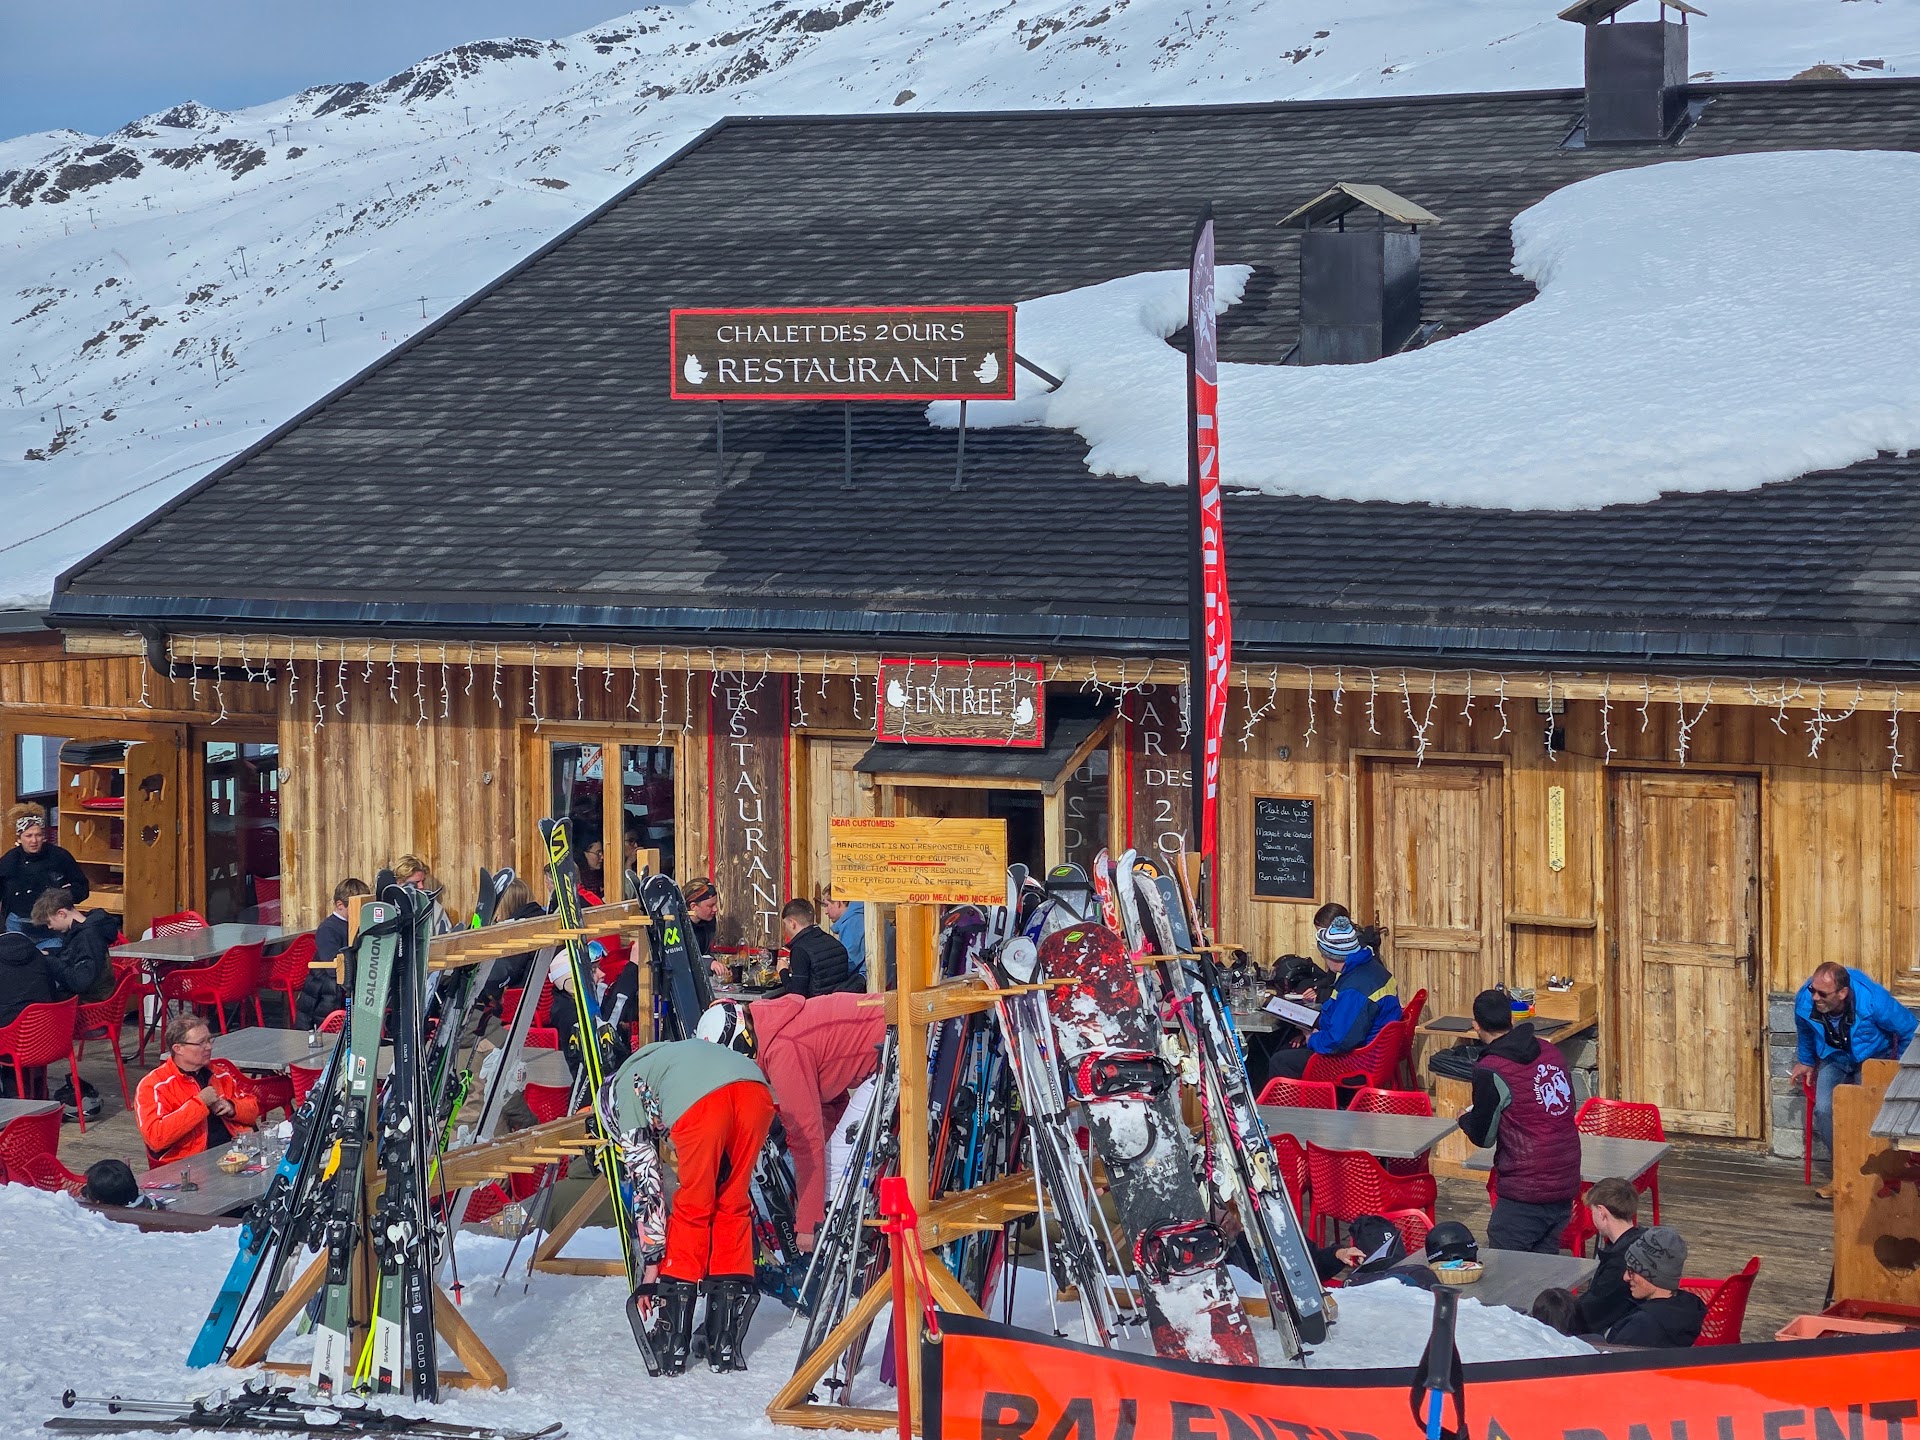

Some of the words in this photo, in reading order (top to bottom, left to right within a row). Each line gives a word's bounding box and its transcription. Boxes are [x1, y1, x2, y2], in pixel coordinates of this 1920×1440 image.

[717, 324, 816, 343] CHALET
[820, 323, 867, 342] DES
[718, 357, 967, 384] RESTAURANT
[915, 686, 1003, 715] ENTREE
[720, 670, 778, 934] RESTAURANT
[831, 818, 851, 827] DEAR
[852, 819, 895, 828] CUSTOMERS
[854, 853, 874, 861] LOSS
[917, 843, 972, 851] RESPONSIBLE
[974, 844, 990, 852] FOR
[848, 864, 889, 873] DIRECTION
[914, 865, 929, 874] PAS
[930, 866, 981, 875] RESPONSABLE
[860, 876, 884, 884] PERTE
[909, 893, 930, 901] GOOD
[932, 893, 952, 902] MEAL
[954, 894, 969, 902] AND
[971, 894, 989, 903] NICE
[990, 895, 1004, 904] DAY
[364, 935, 382, 1008] SALOMON
[781, 1221, 799, 1255] CLOUD
[415, 1332, 426, 1369] CLOUD
[981, 1391, 1380, 1440] RALEN
